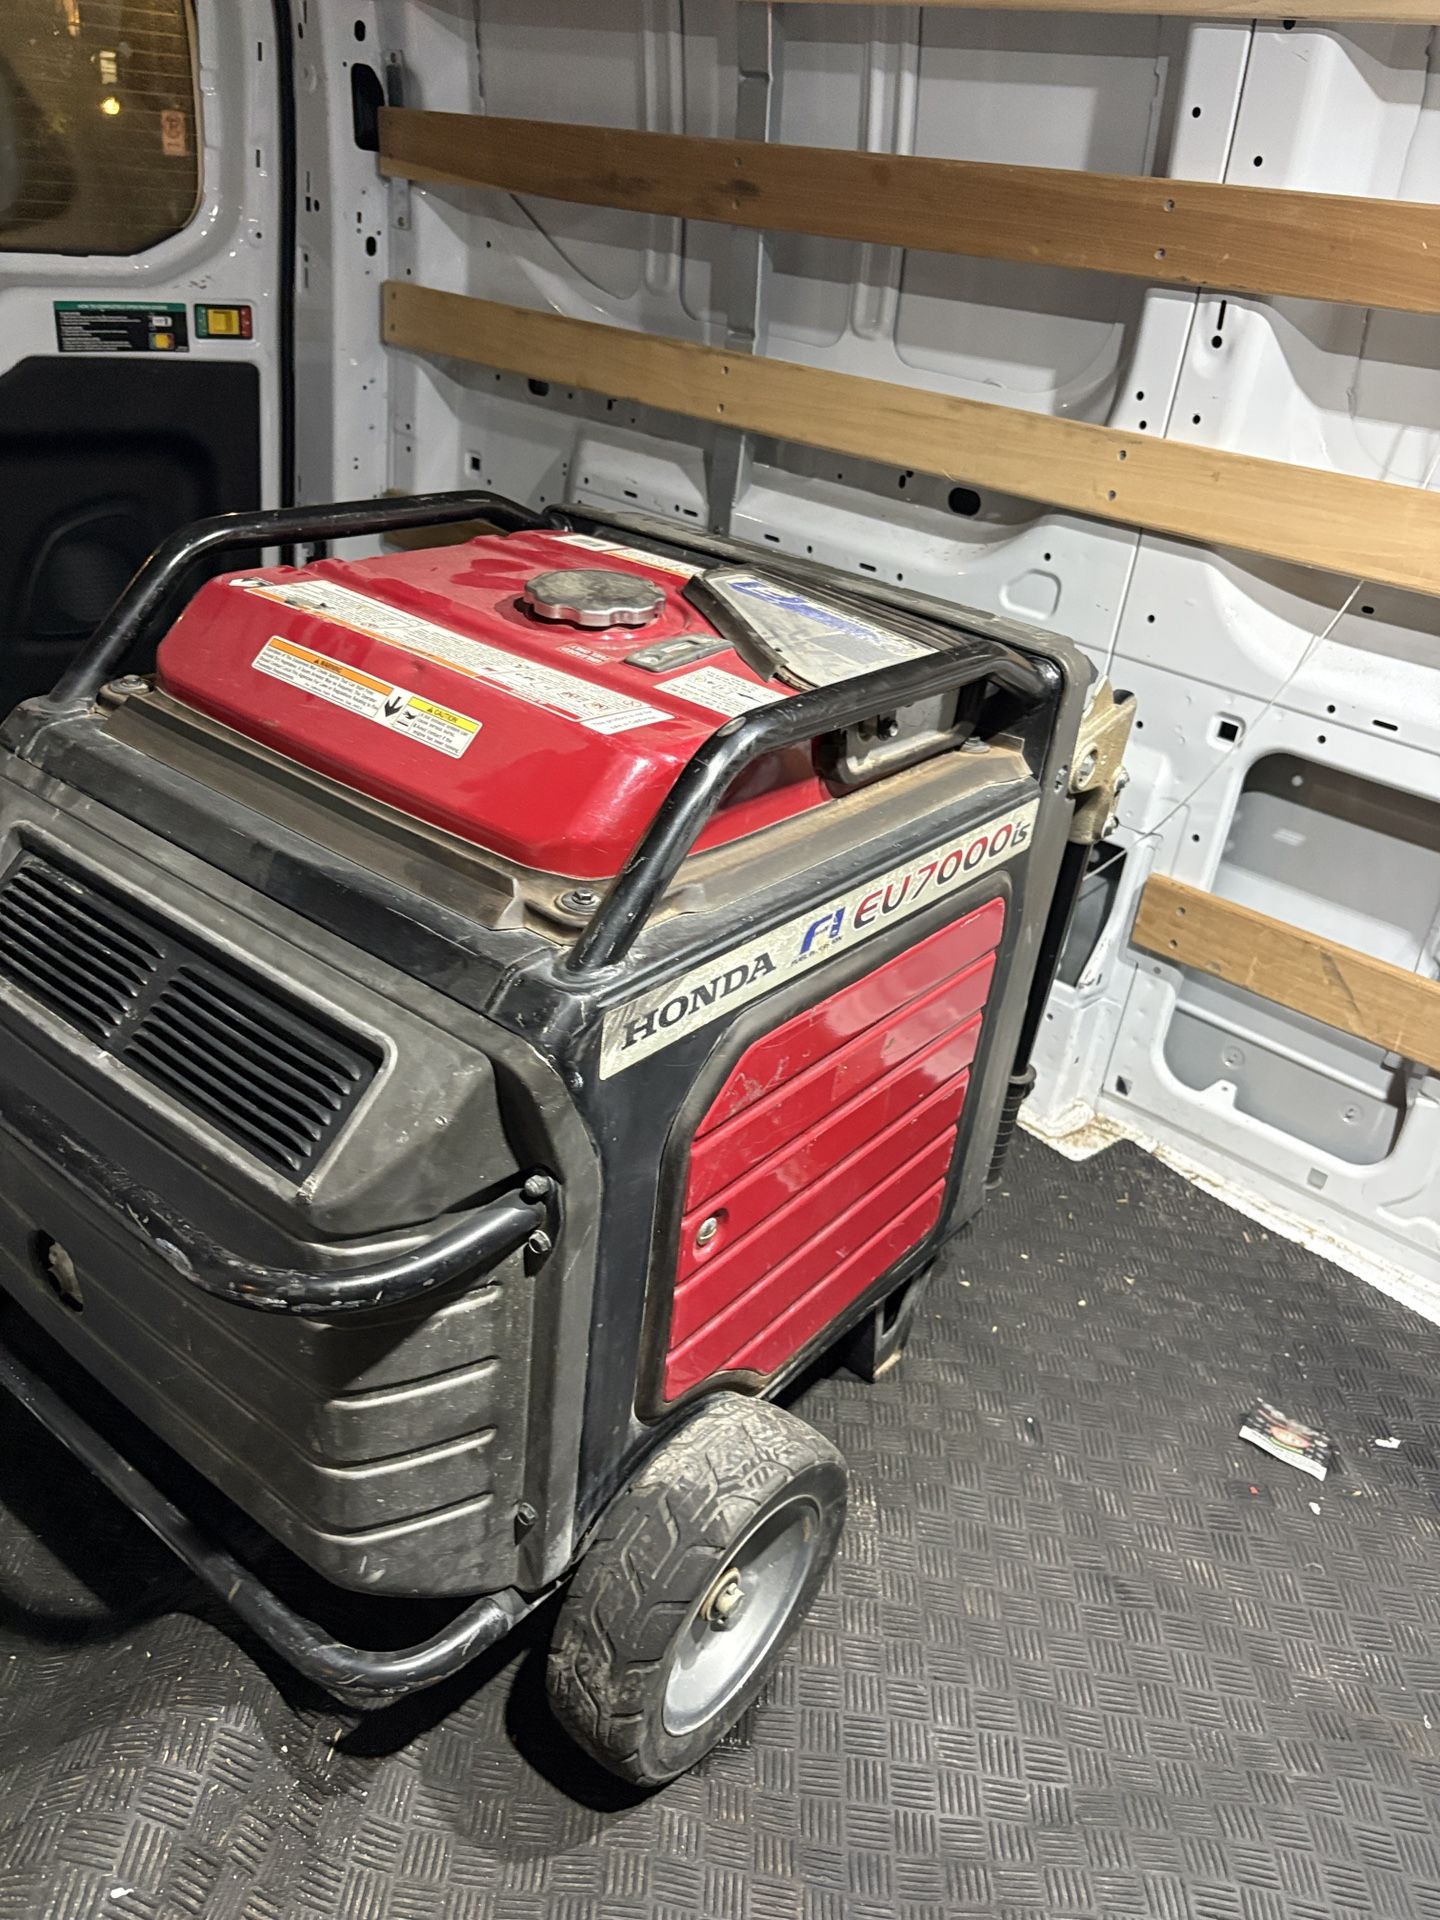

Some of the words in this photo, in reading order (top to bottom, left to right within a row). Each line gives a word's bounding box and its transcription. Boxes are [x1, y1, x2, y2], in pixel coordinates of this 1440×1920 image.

[320, 659, 342, 673] WARNING
[433, 708, 458, 723] CAUTION
[621, 951, 777, 1051] HONDA
